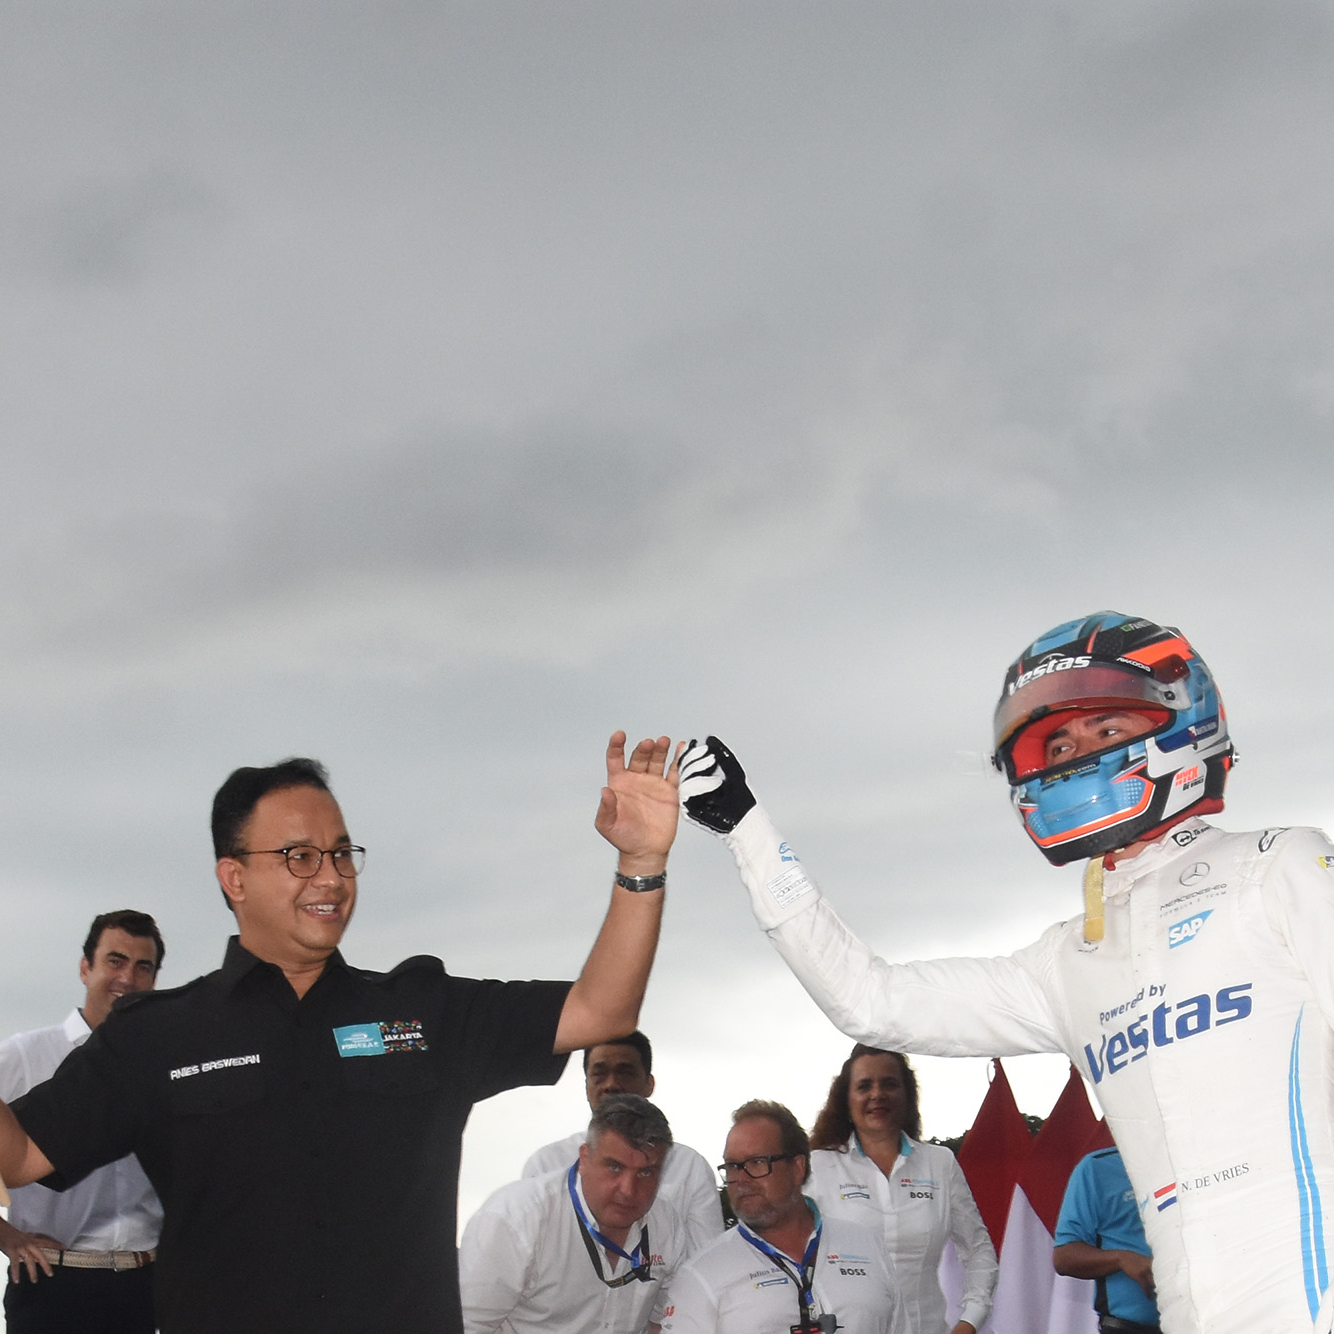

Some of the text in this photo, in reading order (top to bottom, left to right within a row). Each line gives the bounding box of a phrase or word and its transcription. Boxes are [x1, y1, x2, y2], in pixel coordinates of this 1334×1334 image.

[1009, 656, 1092, 696] Vestas
[1170, 917, 1204, 945] SAP
[1100, 983, 1167, 1026] Powered by
[383, 1032, 423, 1041] JAKARTA
[1084, 983, 1252, 1084] Vestas
[170, 1054, 260, 1080] ANIES BASWEDAN
[1181, 1162, 1250, 1193] N. DE VRIES
[840, 1268, 866, 1276] BOSS
